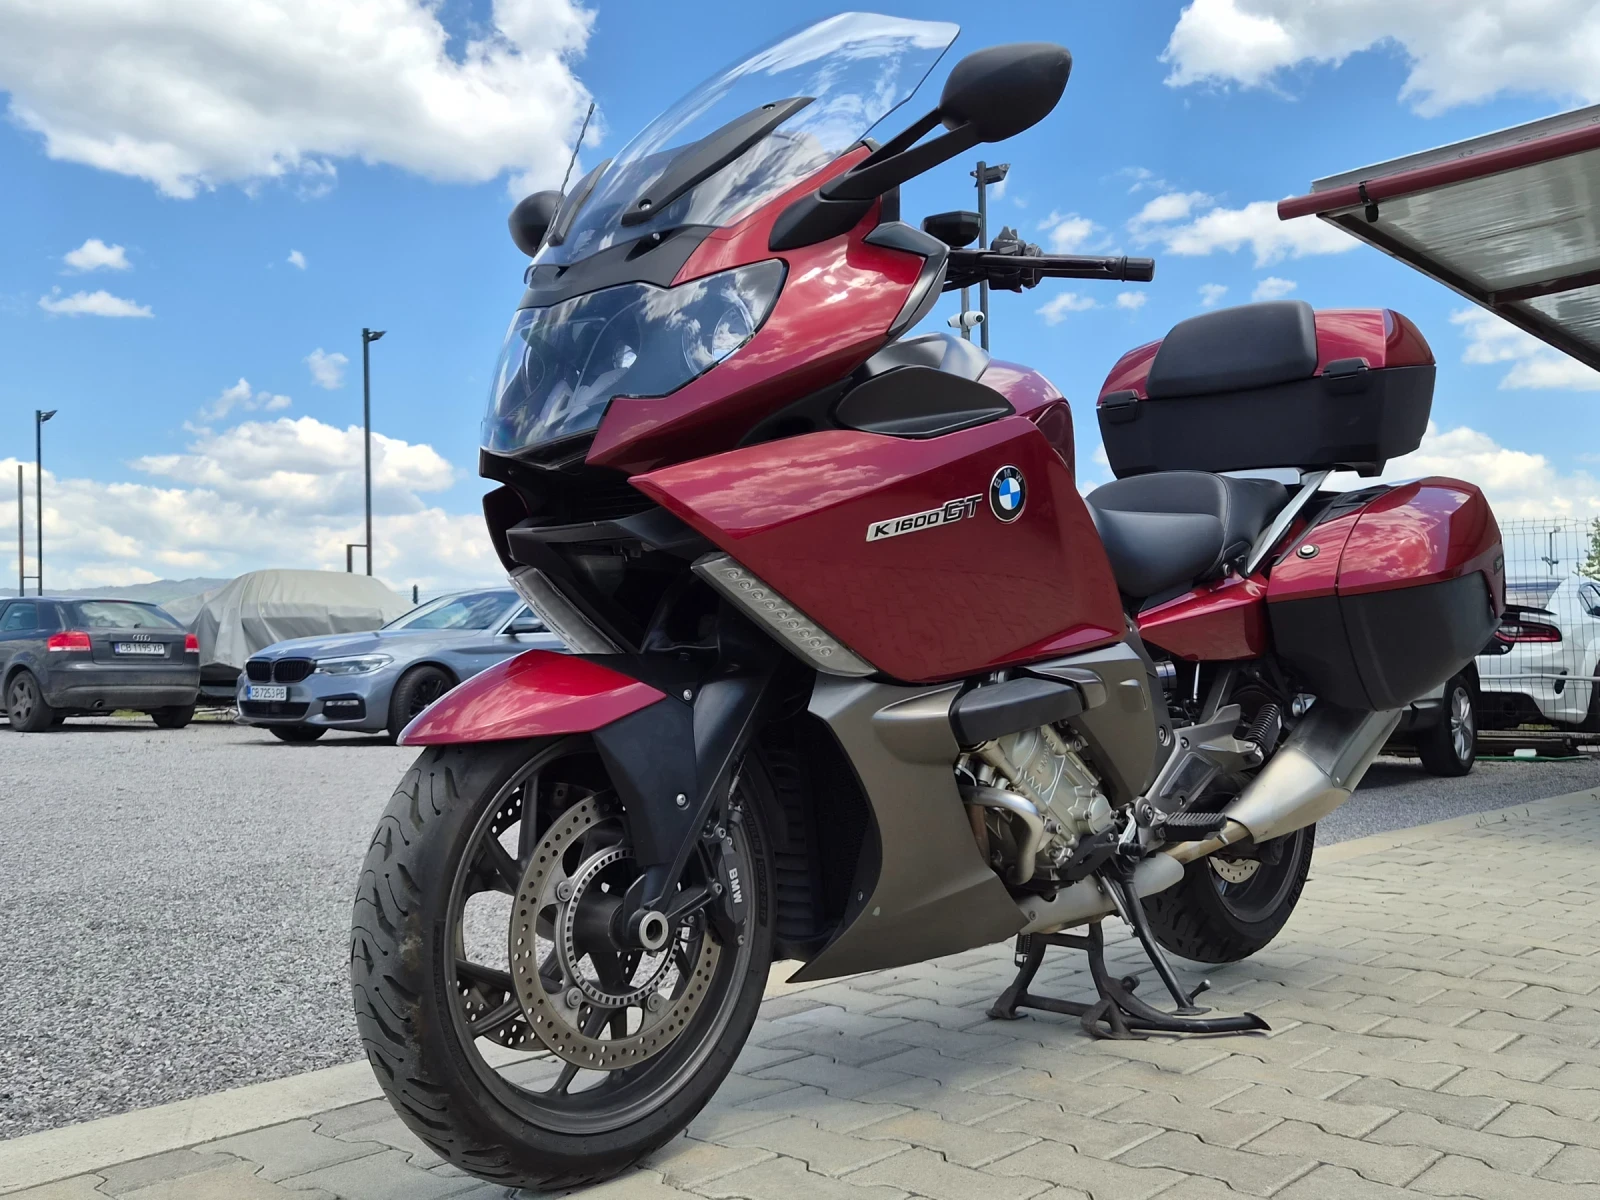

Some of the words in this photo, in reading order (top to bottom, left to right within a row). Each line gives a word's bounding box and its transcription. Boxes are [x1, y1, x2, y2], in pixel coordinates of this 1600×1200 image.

[994, 469, 1023, 489] BMW
[874, 523, 890, 538] K
[894, 511, 940, 533] 1600
[941, 494, 983, 523] GT
[120, 643, 131, 652] CB
[133, 643, 152, 652] 1195
[728, 867, 743, 904] BMW
